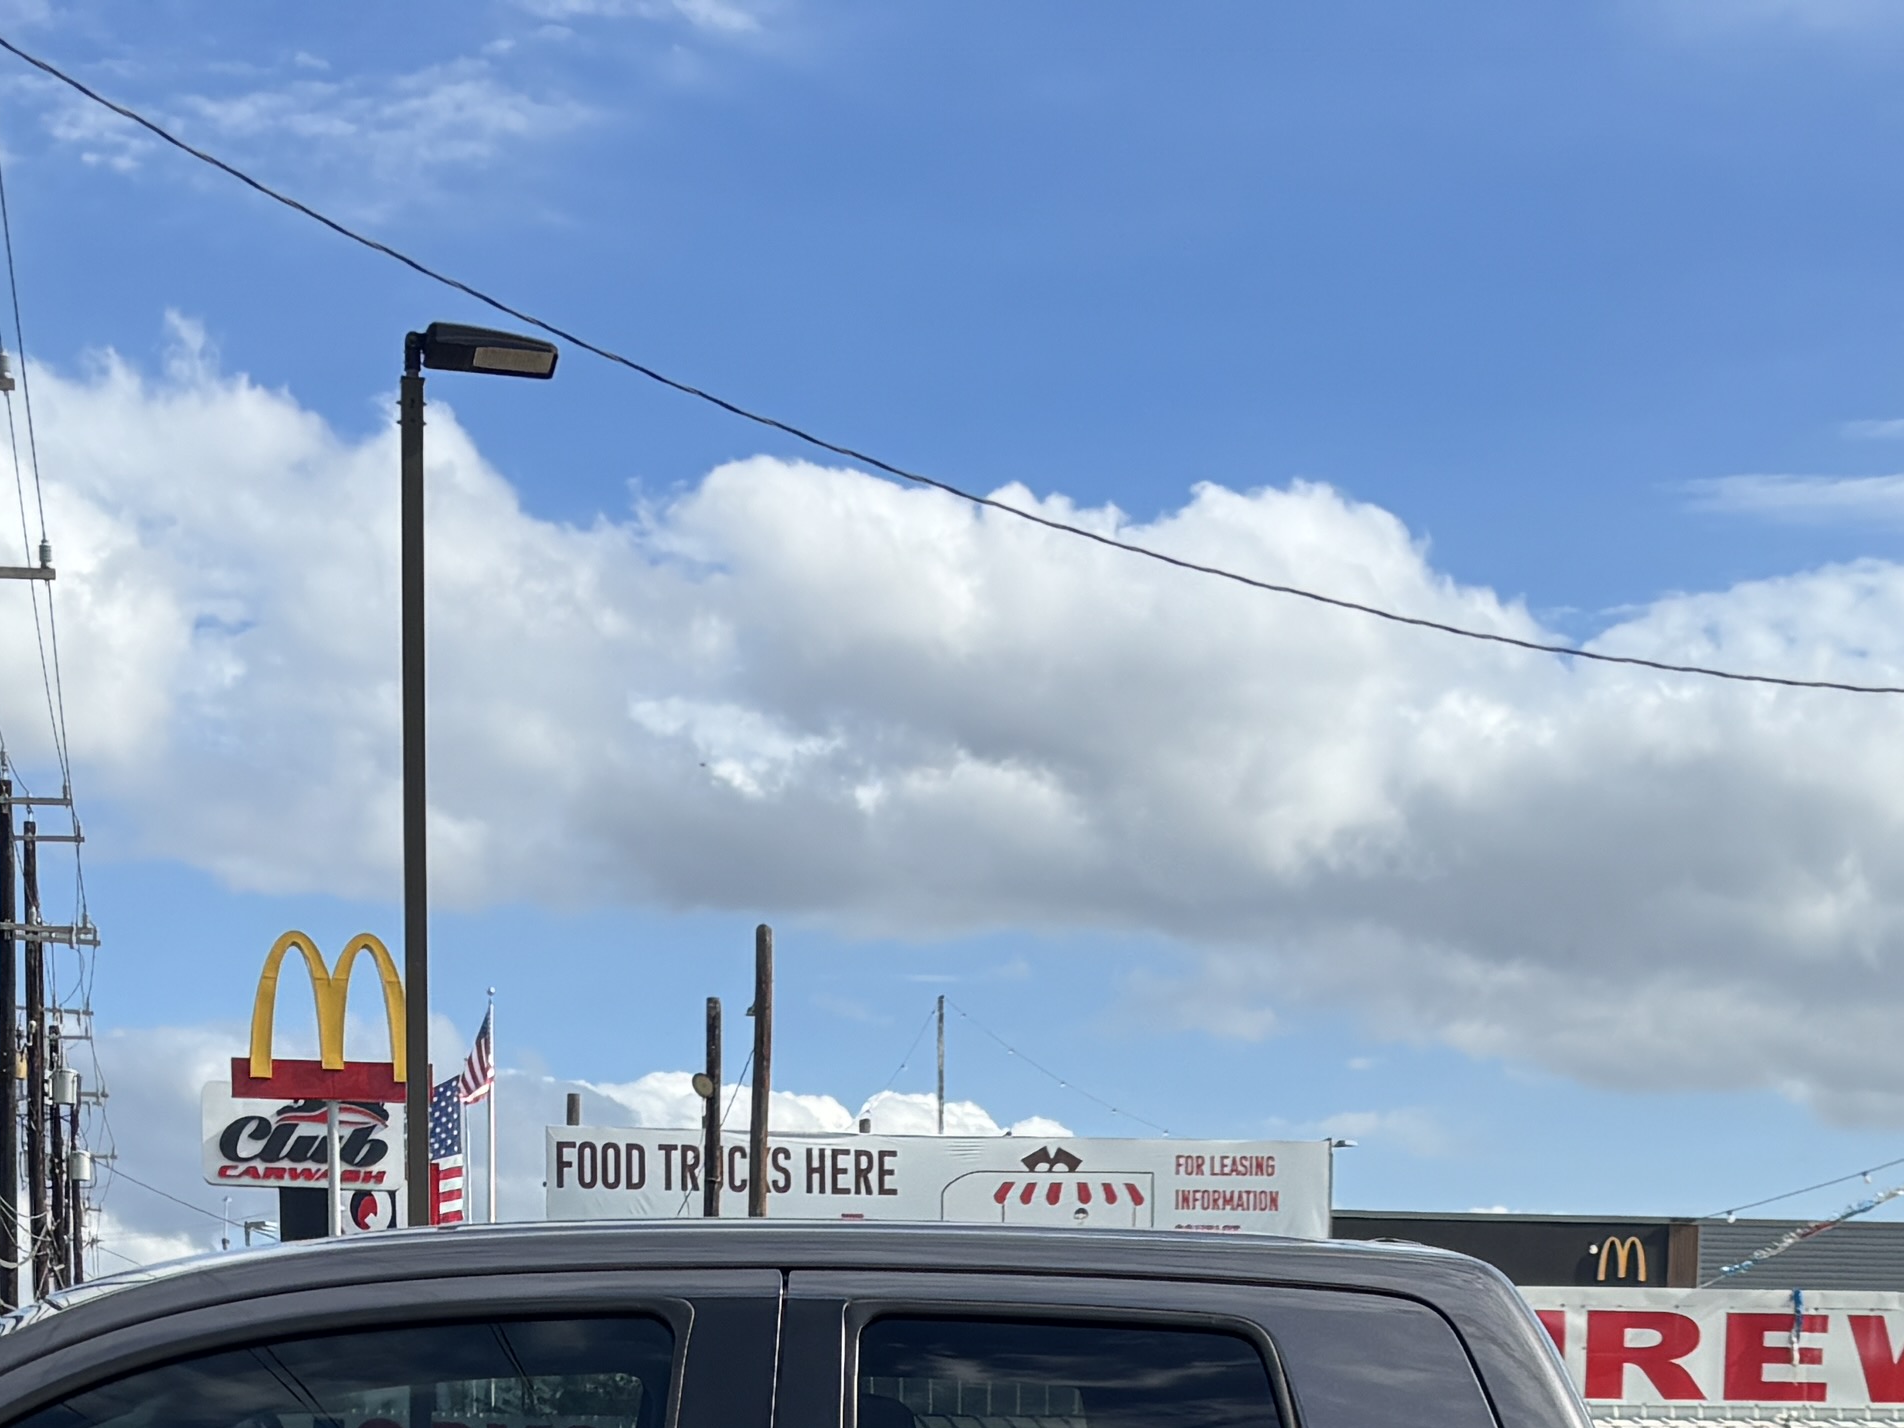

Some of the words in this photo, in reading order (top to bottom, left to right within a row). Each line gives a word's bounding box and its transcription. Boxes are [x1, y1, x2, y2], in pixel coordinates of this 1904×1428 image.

[219, 1115, 389, 1168] Club
[555, 1141, 647, 1190] FOOD
[658, 1143, 792, 1194] TRCS
[805, 1147, 899, 1196] HERE
[1175, 1154, 1205, 1176] FOR
[1209, 1155, 1276, 1177] LEASING
[1174, 1189, 1280, 1212] INFORMATION
